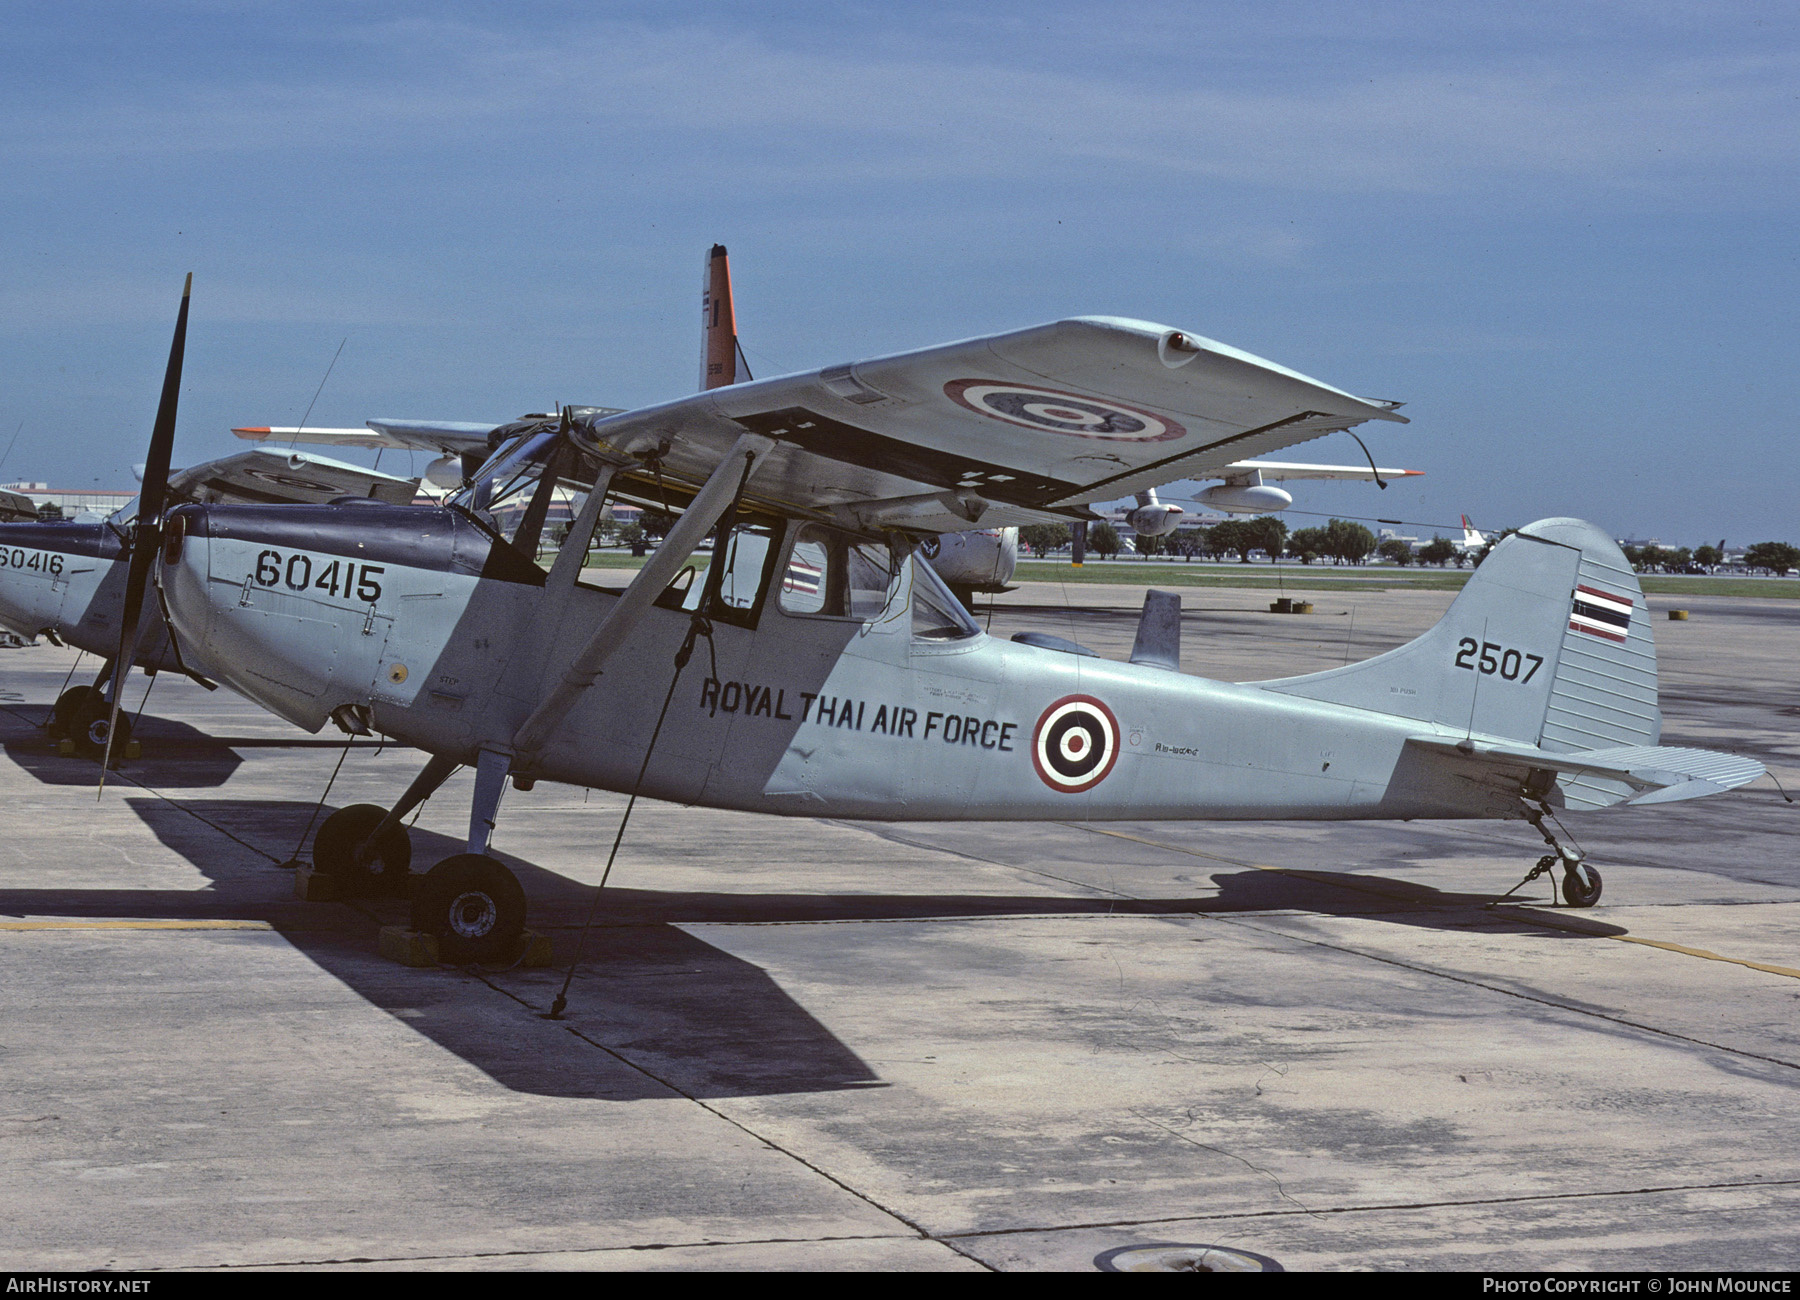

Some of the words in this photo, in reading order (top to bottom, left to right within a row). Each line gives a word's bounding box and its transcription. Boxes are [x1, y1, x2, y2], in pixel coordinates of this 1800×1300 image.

[255, 550, 385, 602] 60415
[440, 676, 459, 686] STEP
[1455, 636, 1544, 685] 2507
[700, 677, 791, 720] ROYAL
[801, 691, 865, 731] THAI
[870, 704, 917, 738] AIR
[924, 711, 1018, 752] FORCE
[1400, 687, 1417, 696] PUSH
